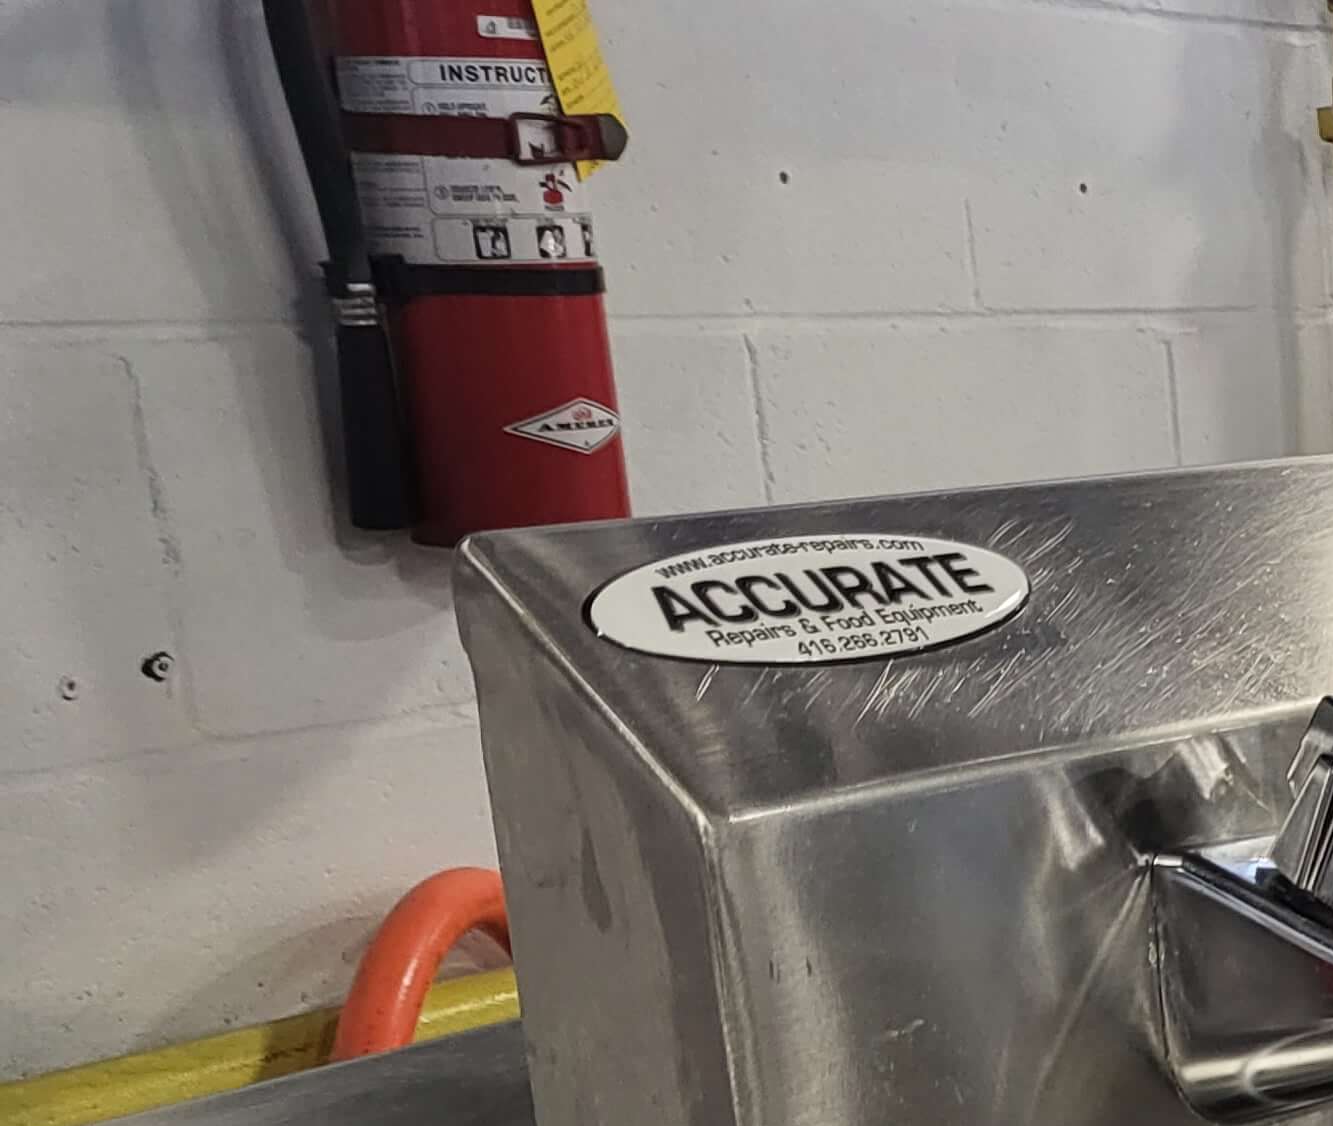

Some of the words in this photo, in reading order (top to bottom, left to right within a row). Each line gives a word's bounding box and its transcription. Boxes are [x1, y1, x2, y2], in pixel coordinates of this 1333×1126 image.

[655, 537, 925, 579] www.accurate-repairs.com
[650, 552, 993, 632] ACCURATE
[705, 622, 797, 648] Repairs
[799, 617, 820, 634] &
[820, 608, 876, 631] Food
[876, 598, 984, 627] Equipment
[797, 626, 931, 657] 416.266.2791
